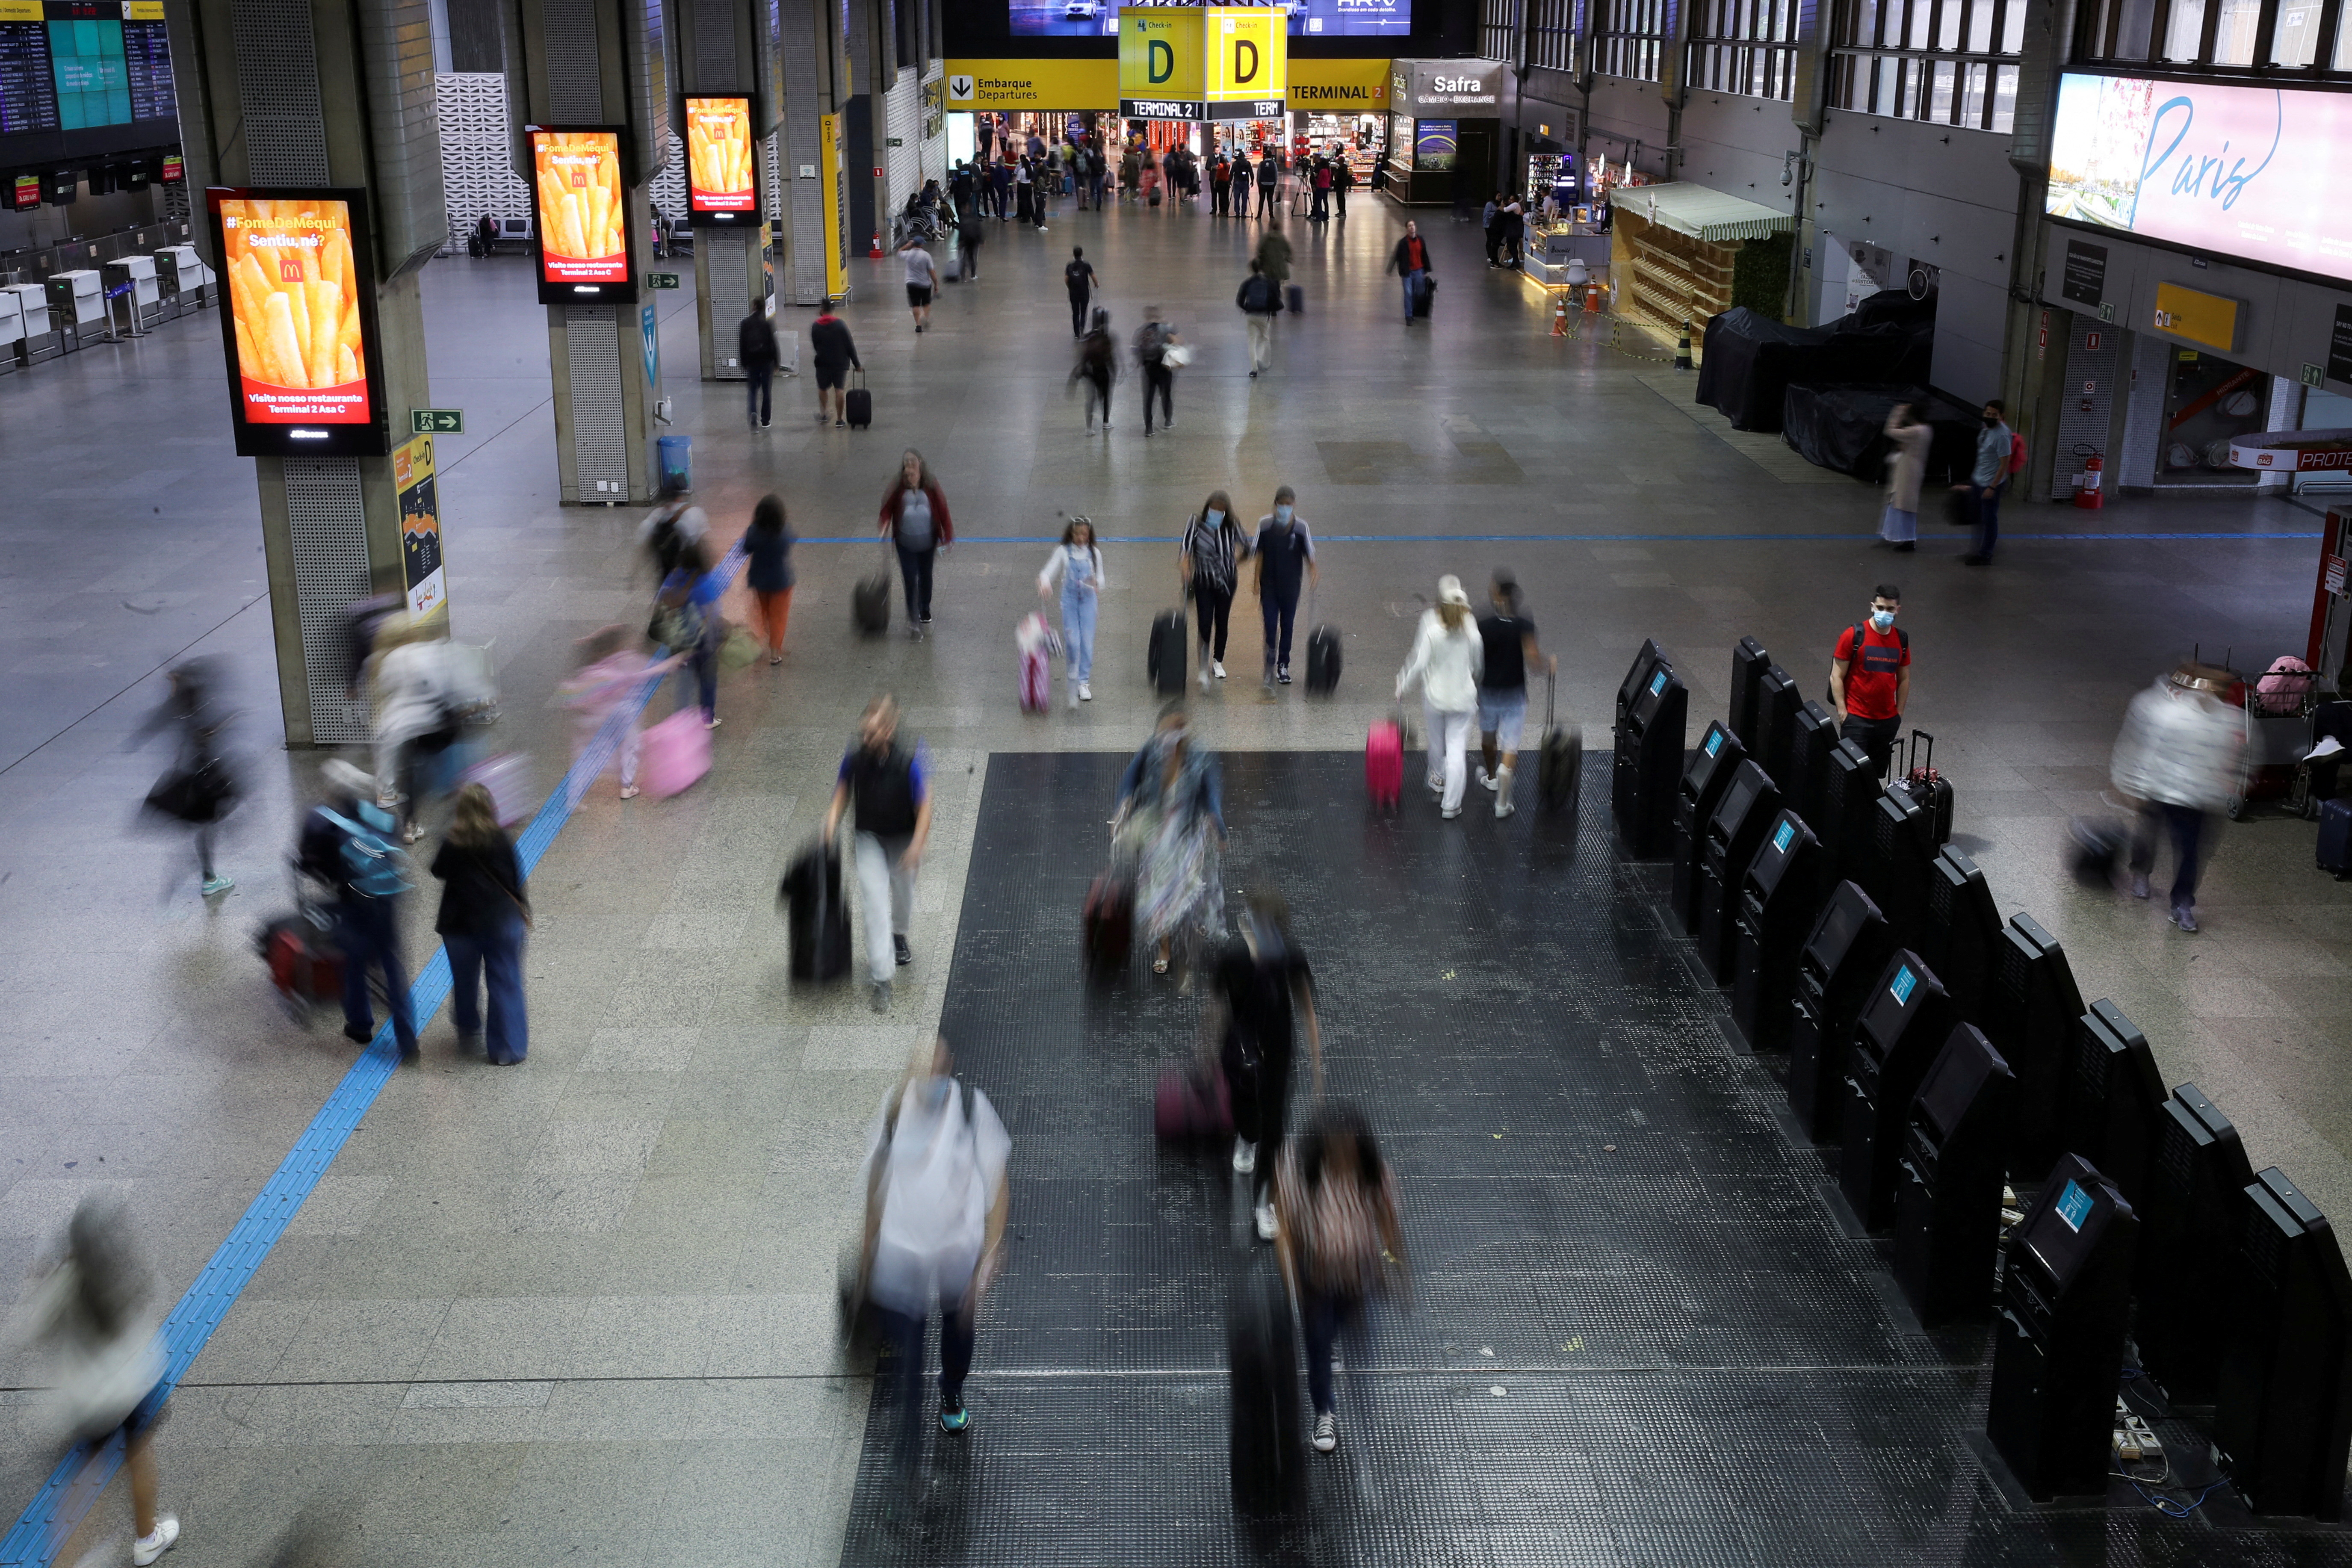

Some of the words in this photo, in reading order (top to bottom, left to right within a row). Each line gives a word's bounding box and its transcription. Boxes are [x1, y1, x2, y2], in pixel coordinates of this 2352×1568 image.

[1149, 40, 1173, 83] D
[1235, 40, 1259, 83] D
[978, 78, 1032, 90] Embarque
[1434, 76, 1481, 92] Safra
[978, 90, 1037, 102] Departures
[1292, 86, 1369, 99] TERMINAL
[1375, 88, 1381, 97] 2
[1418, 94, 1449, 103] CÂMBIO
[1453, 94, 1495, 103] EXCHANGE
[1132, 101, 1183, 117] TERMINAL
[1185, 103, 1192, 118] 2
[1254, 102, 1279, 116] TERM
[552, 155, 585, 165] Sentiu,
[585, 154, 602, 164] né?
[2129, 89, 2282, 230] Paris
[249, 233, 299, 249] Sentiu,
[301, 233, 325, 247] né?
[2172, 312, 2181, 322] Saída
[2216, 370, 2250, 396] HIDRANTE
[248, 393, 277, 403] Visite
[307, 394, 363, 403] restaurante
[268, 405, 310, 413] Terminal
[311, 405, 318, 413] 2
[319, 405, 337, 413] Asa
[337, 405, 346, 413] C
[413, 451, 425, 464] Check-in
[424, 440, 431, 466] D
[398, 471, 408, 483] Terminal
[408, 464, 412, 478] 2
[2329, 563, 2343, 573] FECHADO
[2331, 557, 2343, 566] CLOSED
